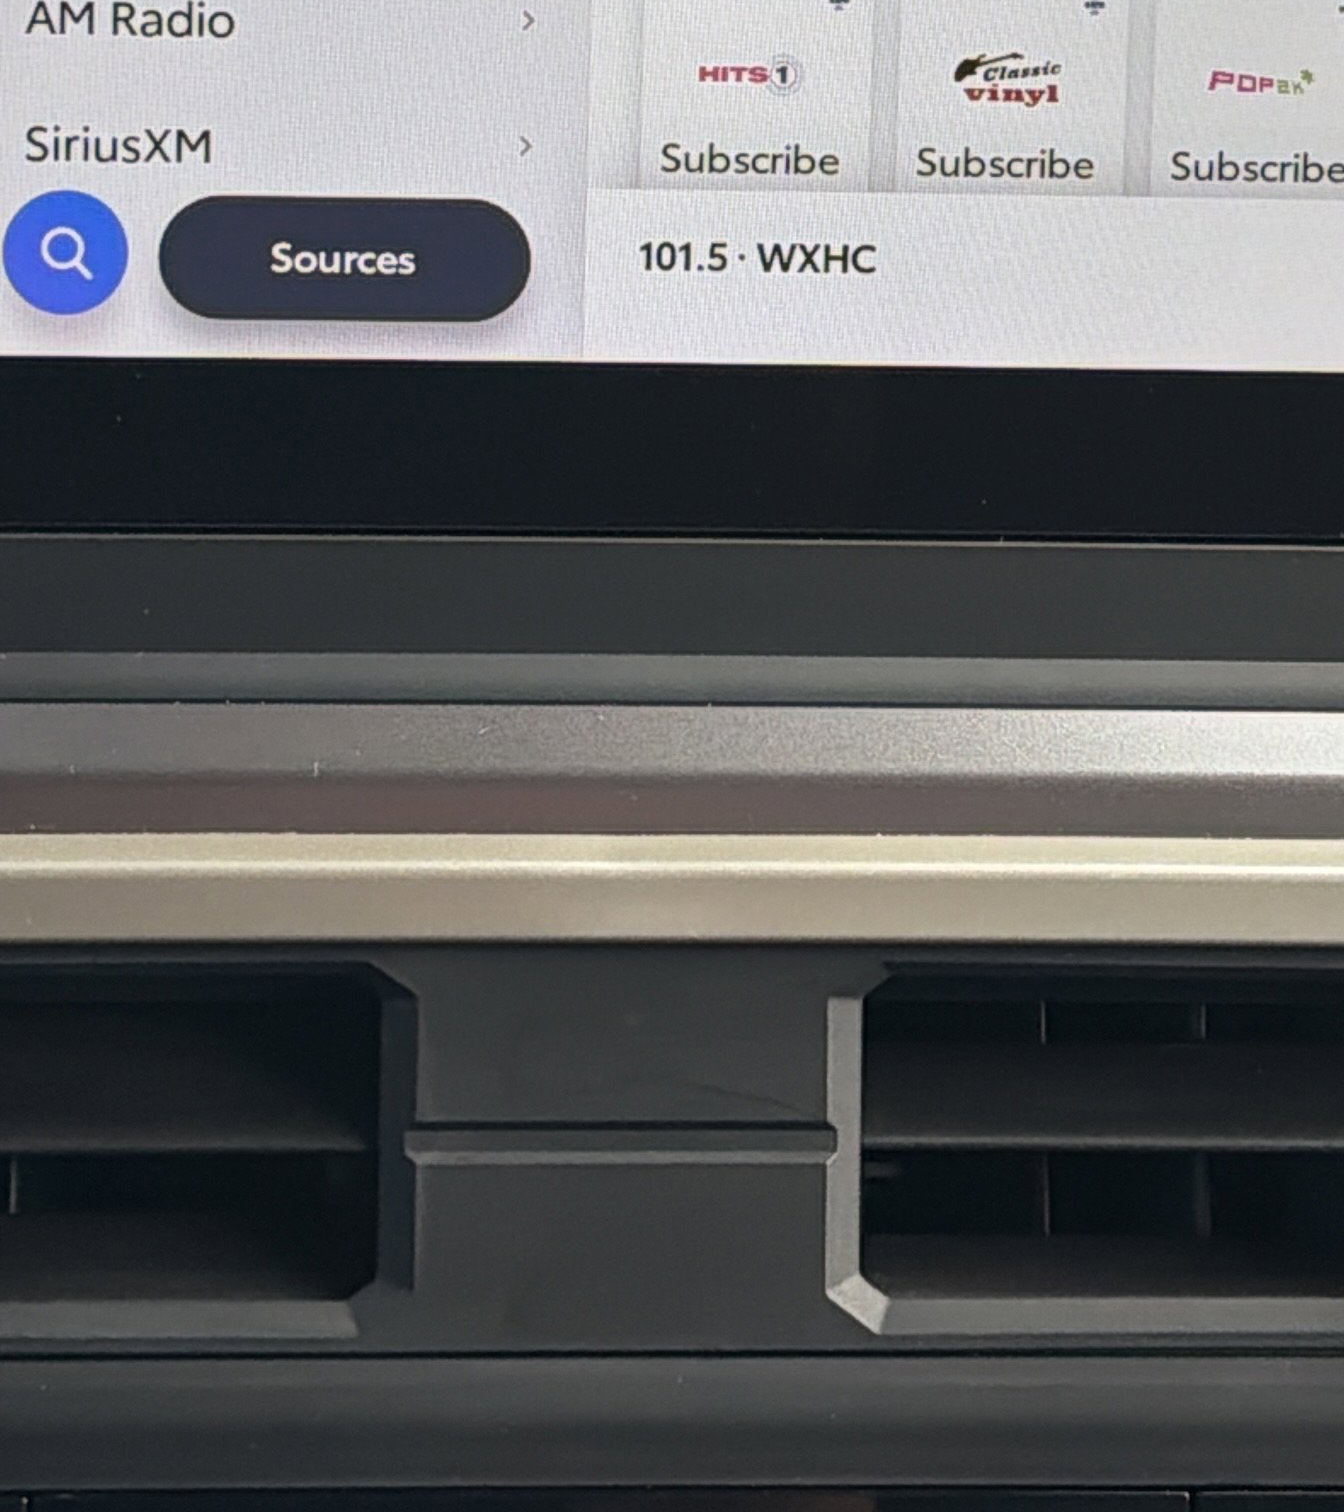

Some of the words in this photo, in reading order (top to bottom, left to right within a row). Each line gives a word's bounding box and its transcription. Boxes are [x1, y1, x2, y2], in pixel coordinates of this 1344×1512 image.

[25, 0, 94, 35] AM
[110, 0, 235, 39] Radio
[698, 66, 769, 85] HITS
[982, 61, 1062, 83] Classic
[963, 84, 1060, 108] vinyl
[25, 125, 211, 164] SiriusXM
[661, 142, 840, 176] Subscribe
[916, 146, 1095, 180] Subscribe
[269, 241, 417, 275] Sources
[639, 241, 728, 273] 101.5
[757, 243, 877, 275] WXHC
